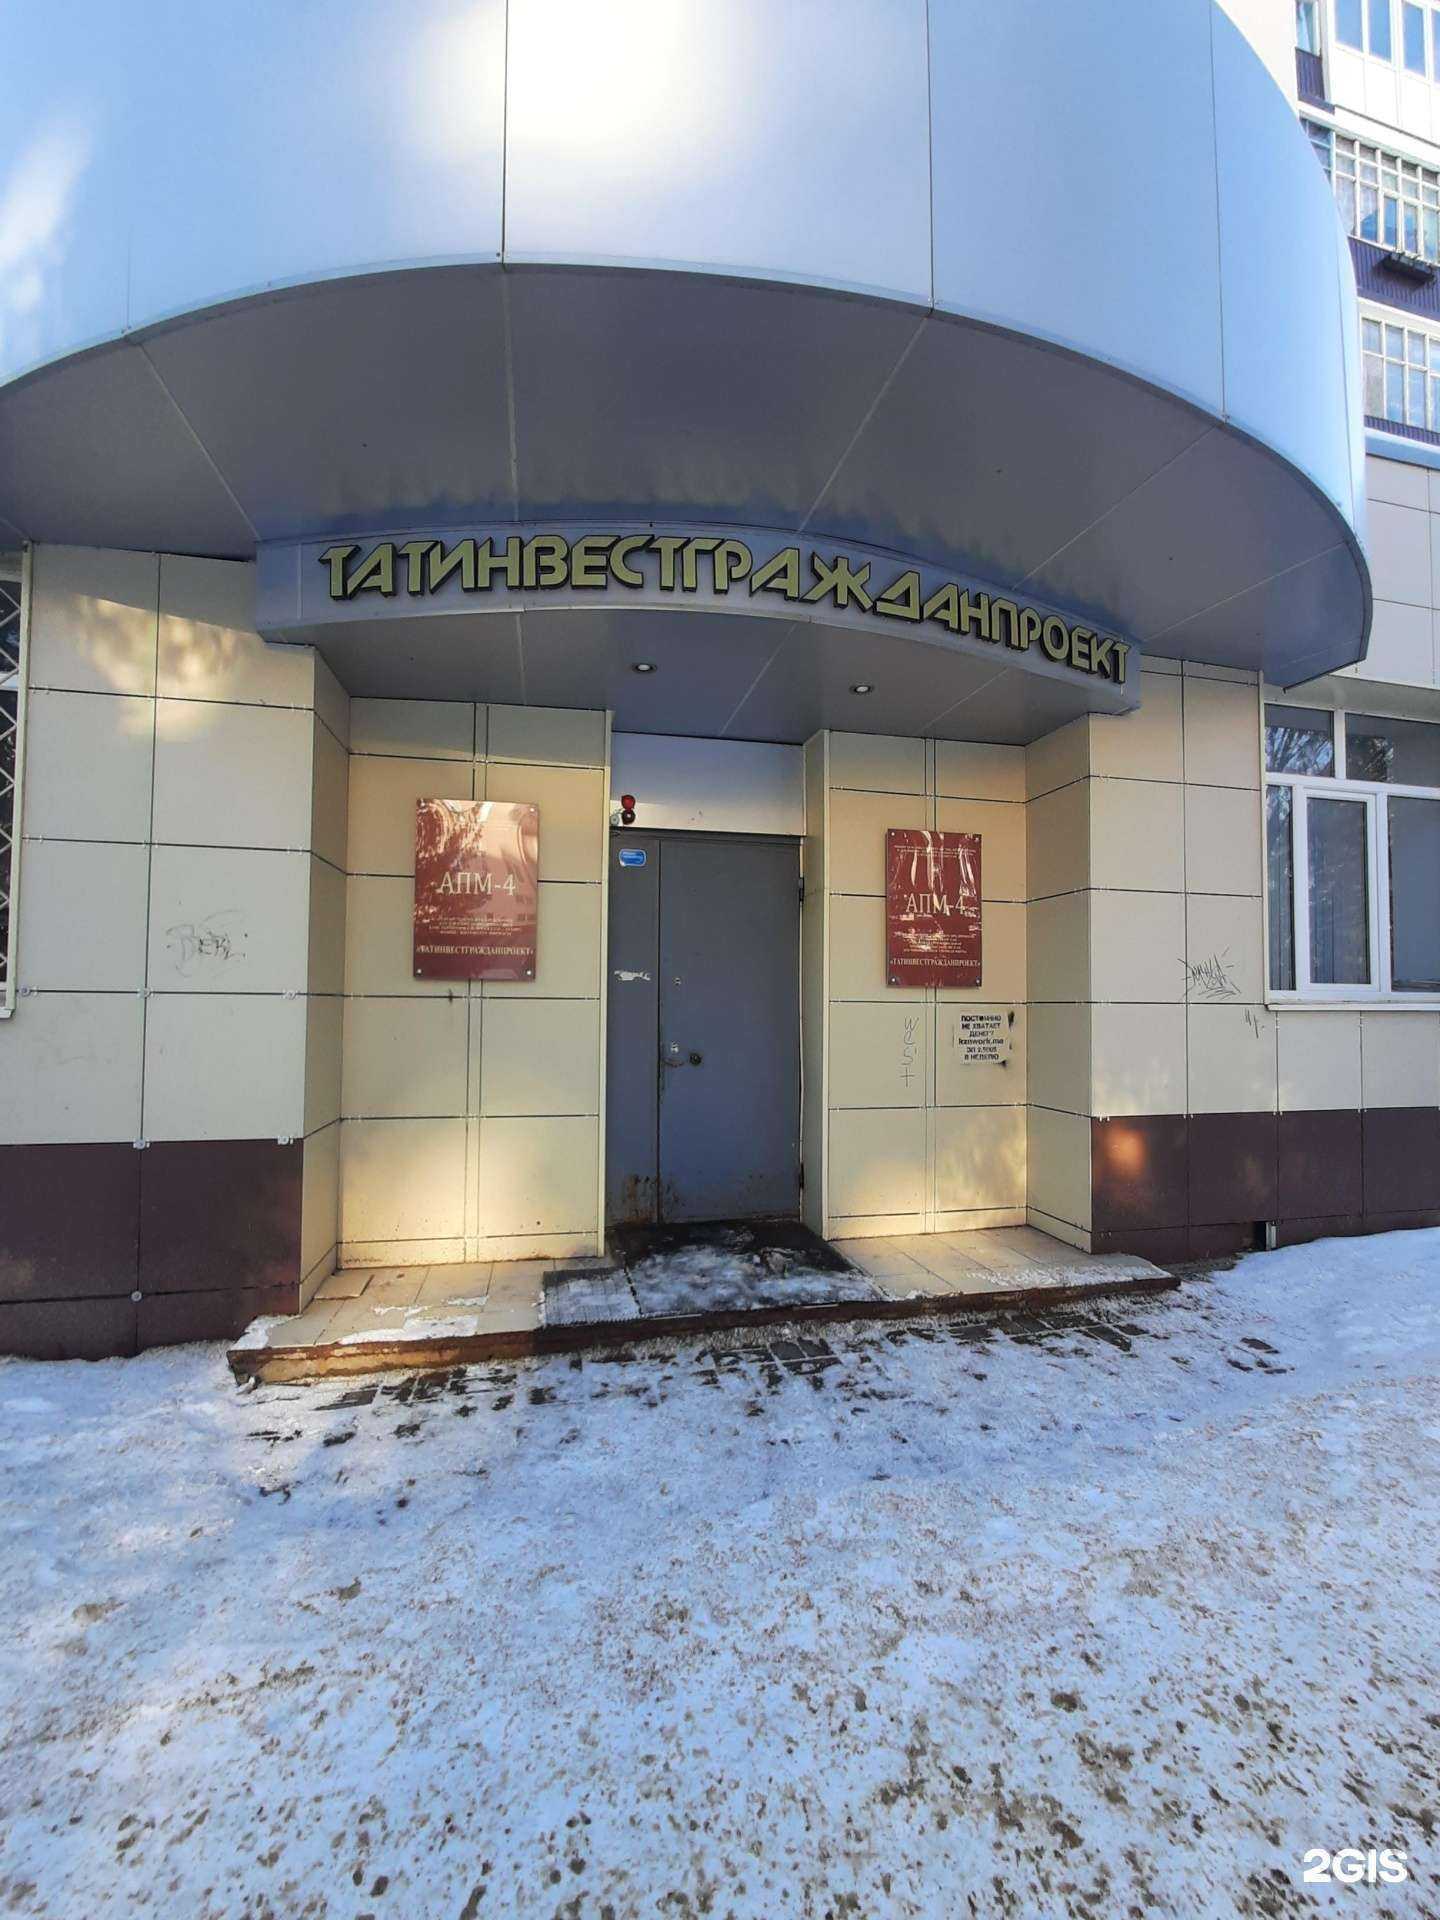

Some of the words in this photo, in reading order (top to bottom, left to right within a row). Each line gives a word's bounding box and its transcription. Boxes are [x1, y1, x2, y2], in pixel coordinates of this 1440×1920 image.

[318, 534, 1131, 684] ТАТИНВЕСТГРАЖДАНПРОЕКТ
[439, 871, 517, 897] АПМ-4
[905, 892, 966, 916] АПМ-4
